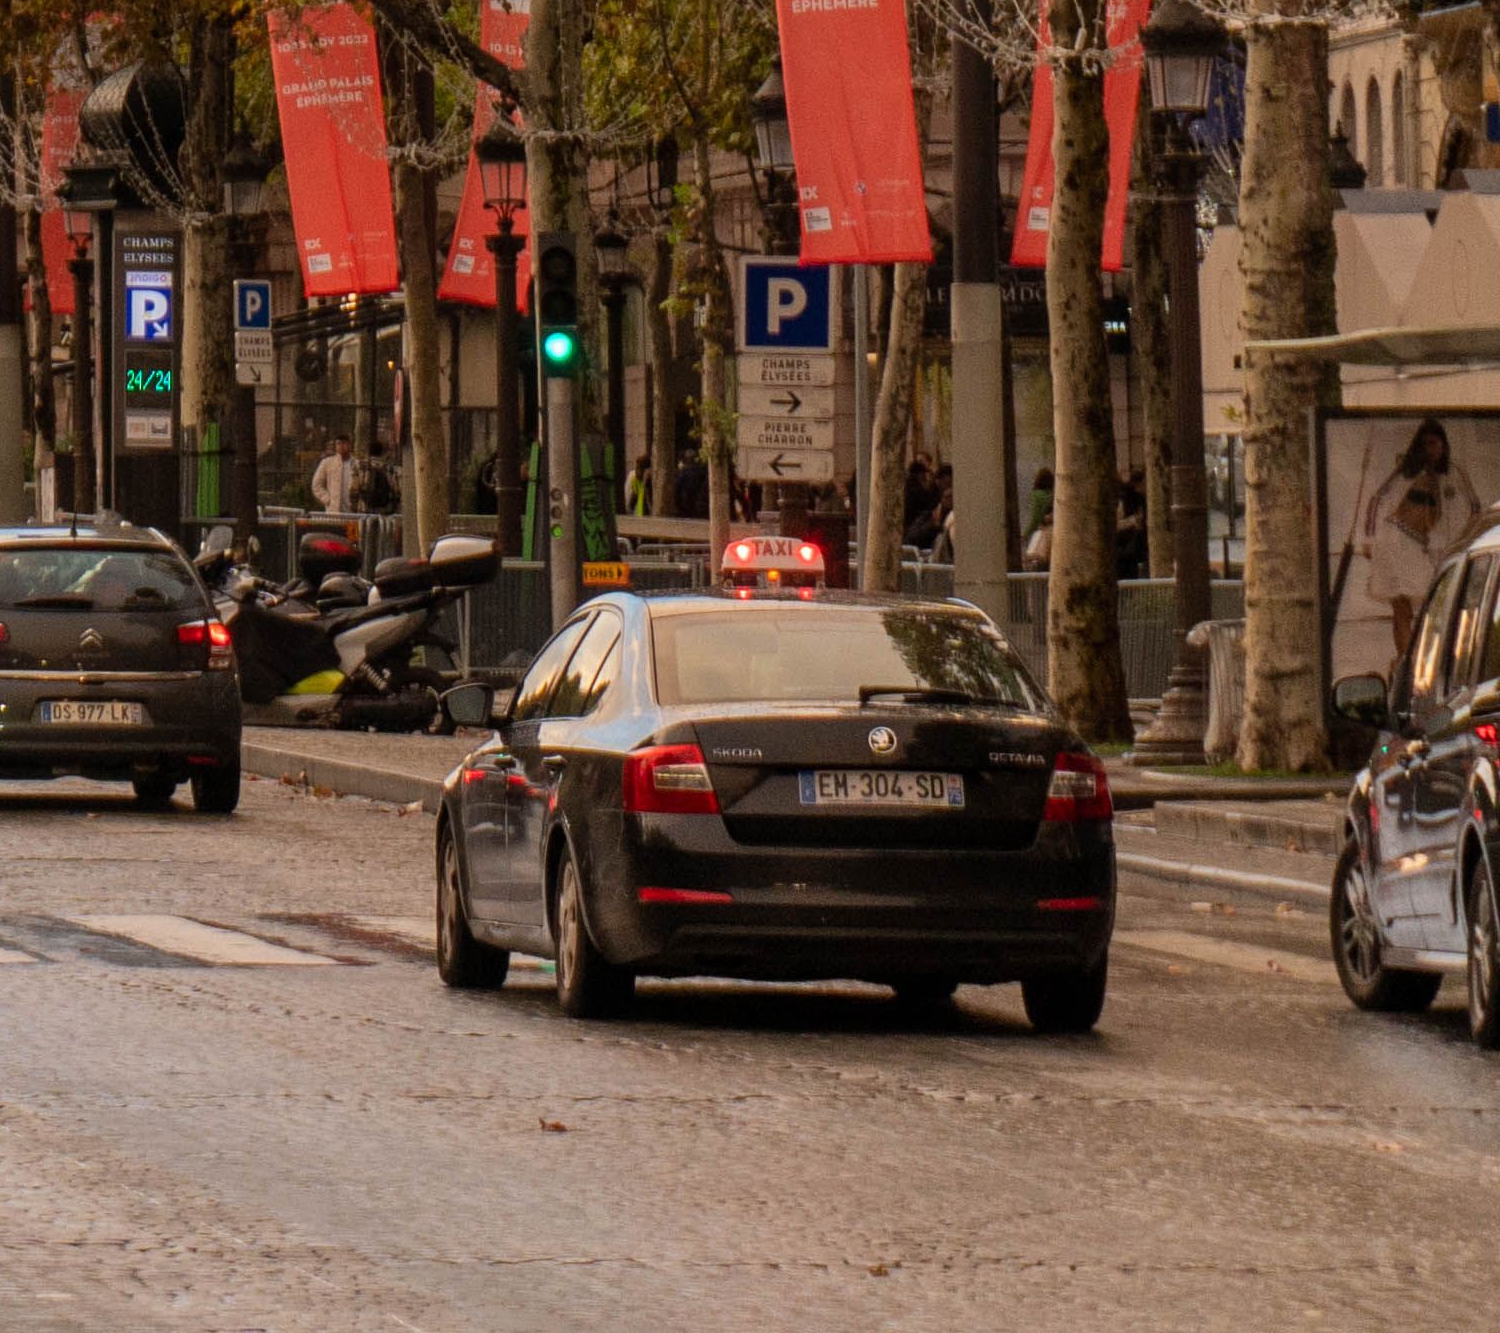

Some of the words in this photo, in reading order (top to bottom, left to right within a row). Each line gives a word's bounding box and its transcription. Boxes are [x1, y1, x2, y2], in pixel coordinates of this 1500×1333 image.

[282, 78, 327, 95] GRAND
[328, 74, 374, 88] PALAIS
[123, 237, 174, 248] CHAMPS
[123, 252, 174, 263] ELYSEES
[131, 289, 168, 337] P
[245, 290, 263, 322] P
[766, 277, 808, 336] P
[762, 358, 811, 370] CHAMPS
[126, 369, 172, 391] 24/24
[764, 421, 807, 433] PIERRE
[757, 433, 813, 446] CHARRON
[751, 539, 793, 557] TAXI
[583, 565, 614, 578] TONS
[819, 773, 945, 799] EM-304-SD
